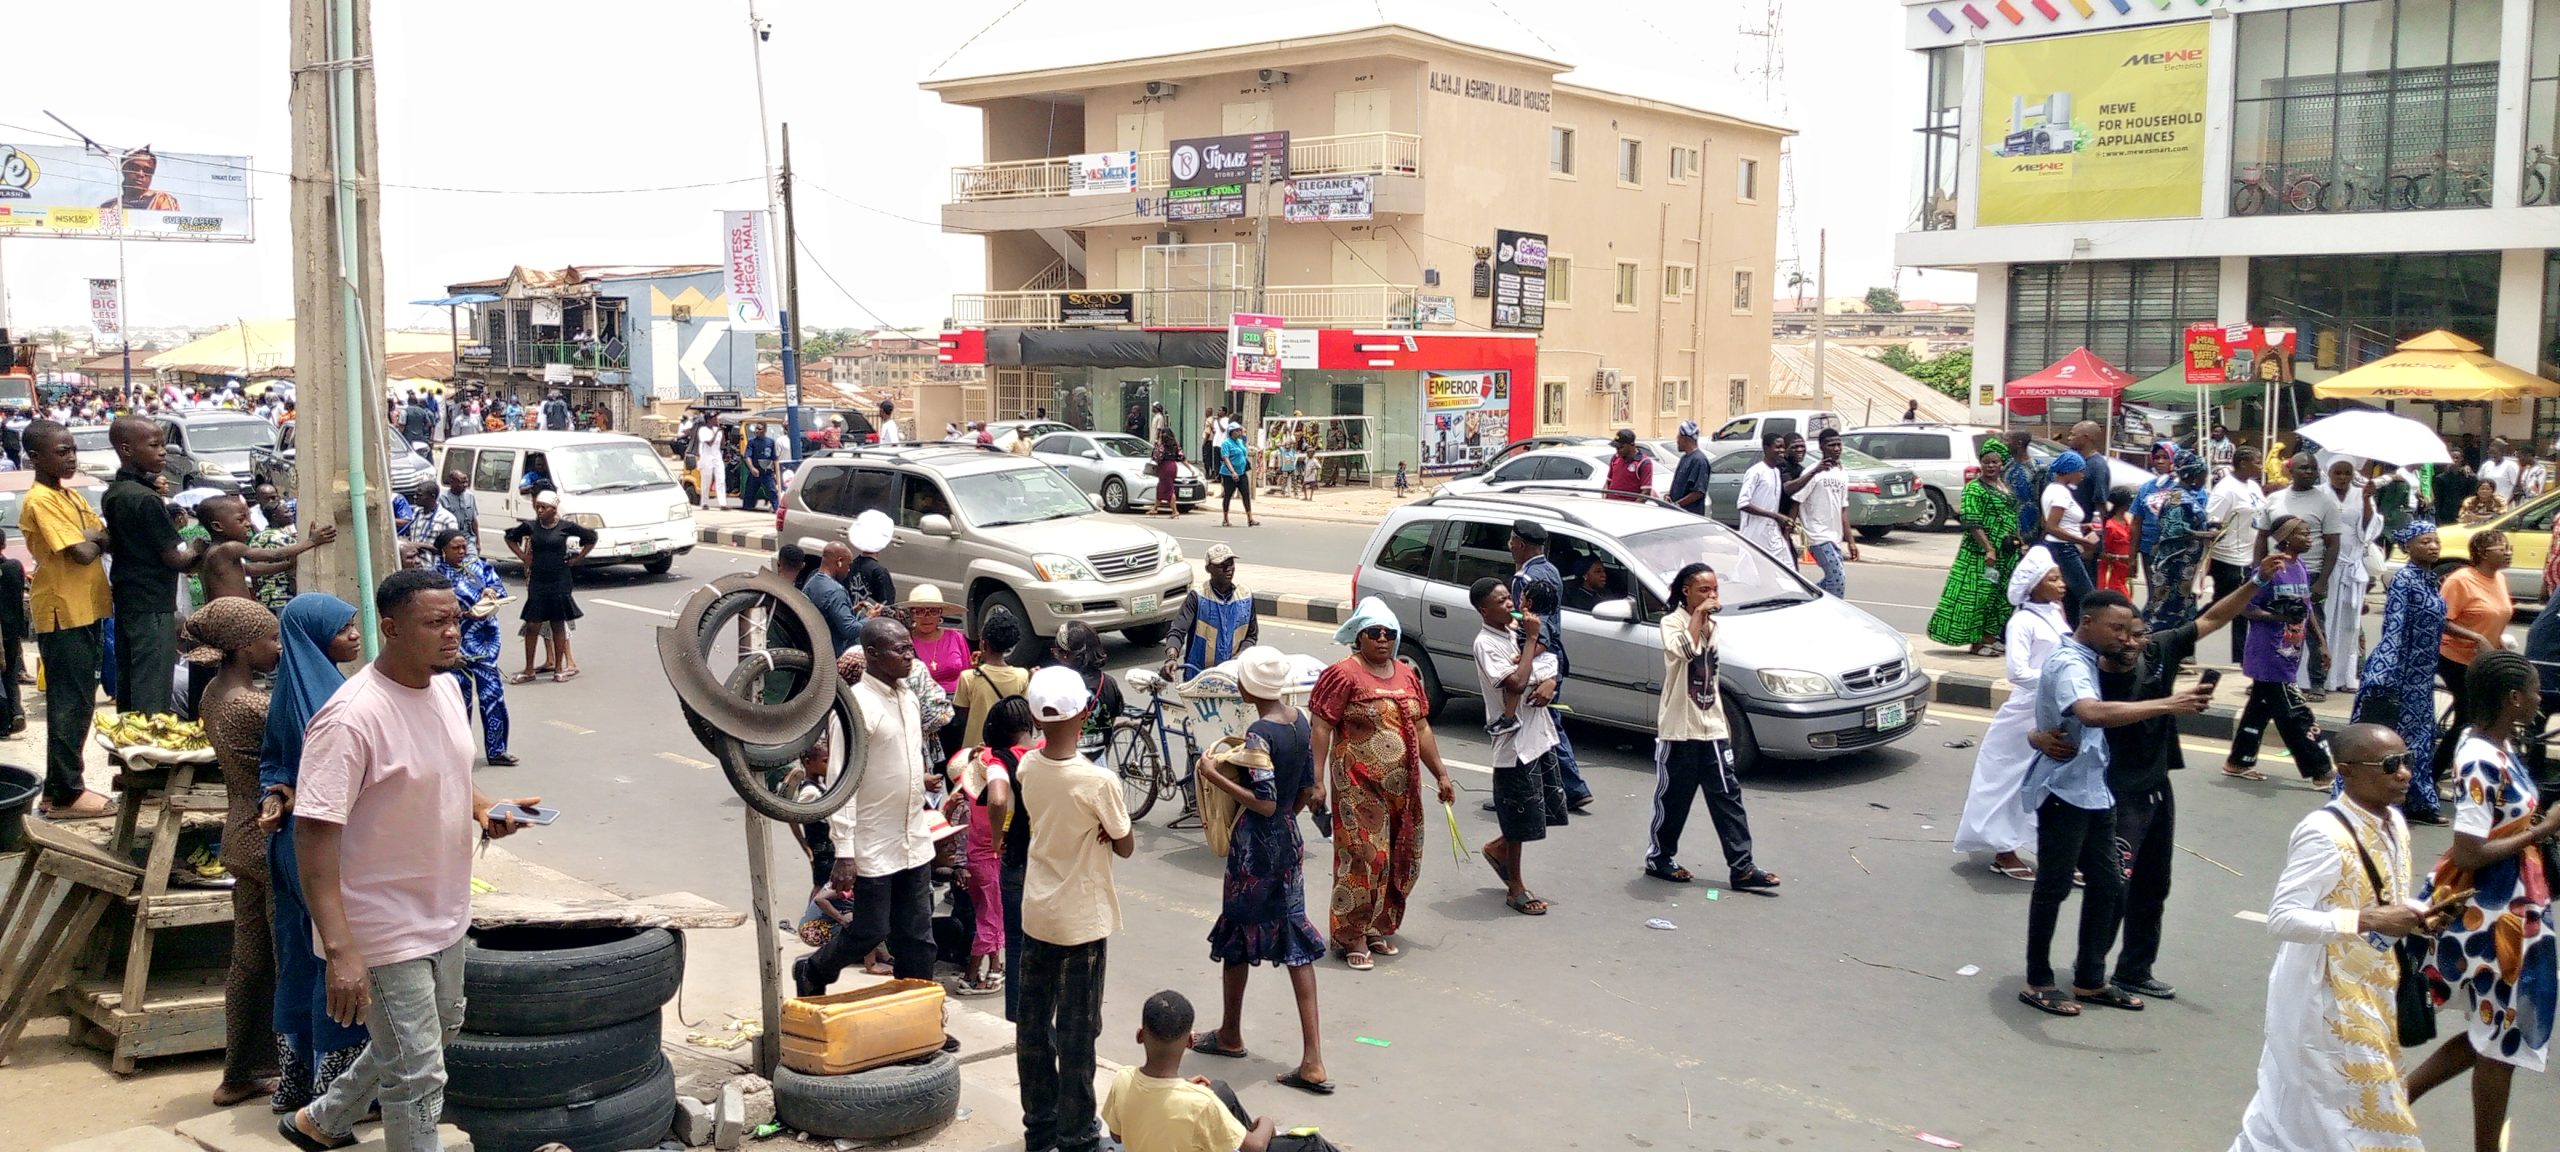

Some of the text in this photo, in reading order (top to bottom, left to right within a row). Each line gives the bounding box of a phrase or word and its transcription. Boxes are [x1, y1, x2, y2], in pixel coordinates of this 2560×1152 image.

[2164, 61, 2203, 71] Electronics
[1430, 71, 1550, 113] ALHAJI ASHIRU ALABI HOUSE
[2099, 102, 2137, 115] MEWE
[2098, 112, 2203, 132] FOR HOUSEHOLD
[2097, 131, 2175, 148] APPLIANCES
[1086, 166, 1129, 180] YASMEEN
[1209, 184, 1242, 195] STORE
[1298, 180, 1353, 191] ELEGANCE
[1136, 197, 1150, 217] NO
[162, 215, 223, 226] GUEST ARTIST
[742, 211, 756, 294] MEGA MALL
[1519, 240, 1546, 258] Cakes
[732, 229, 746, 294] MAMTESS
[92, 299, 117, 310] BIG
[93, 311, 117, 319] LESS
[1428, 380, 1479, 395] EMPEROR
[2025, 388, 2055, 396] REASON
[2057, 388, 2067, 396] TO
[2067, 388, 2100, 396] IMAGINE
